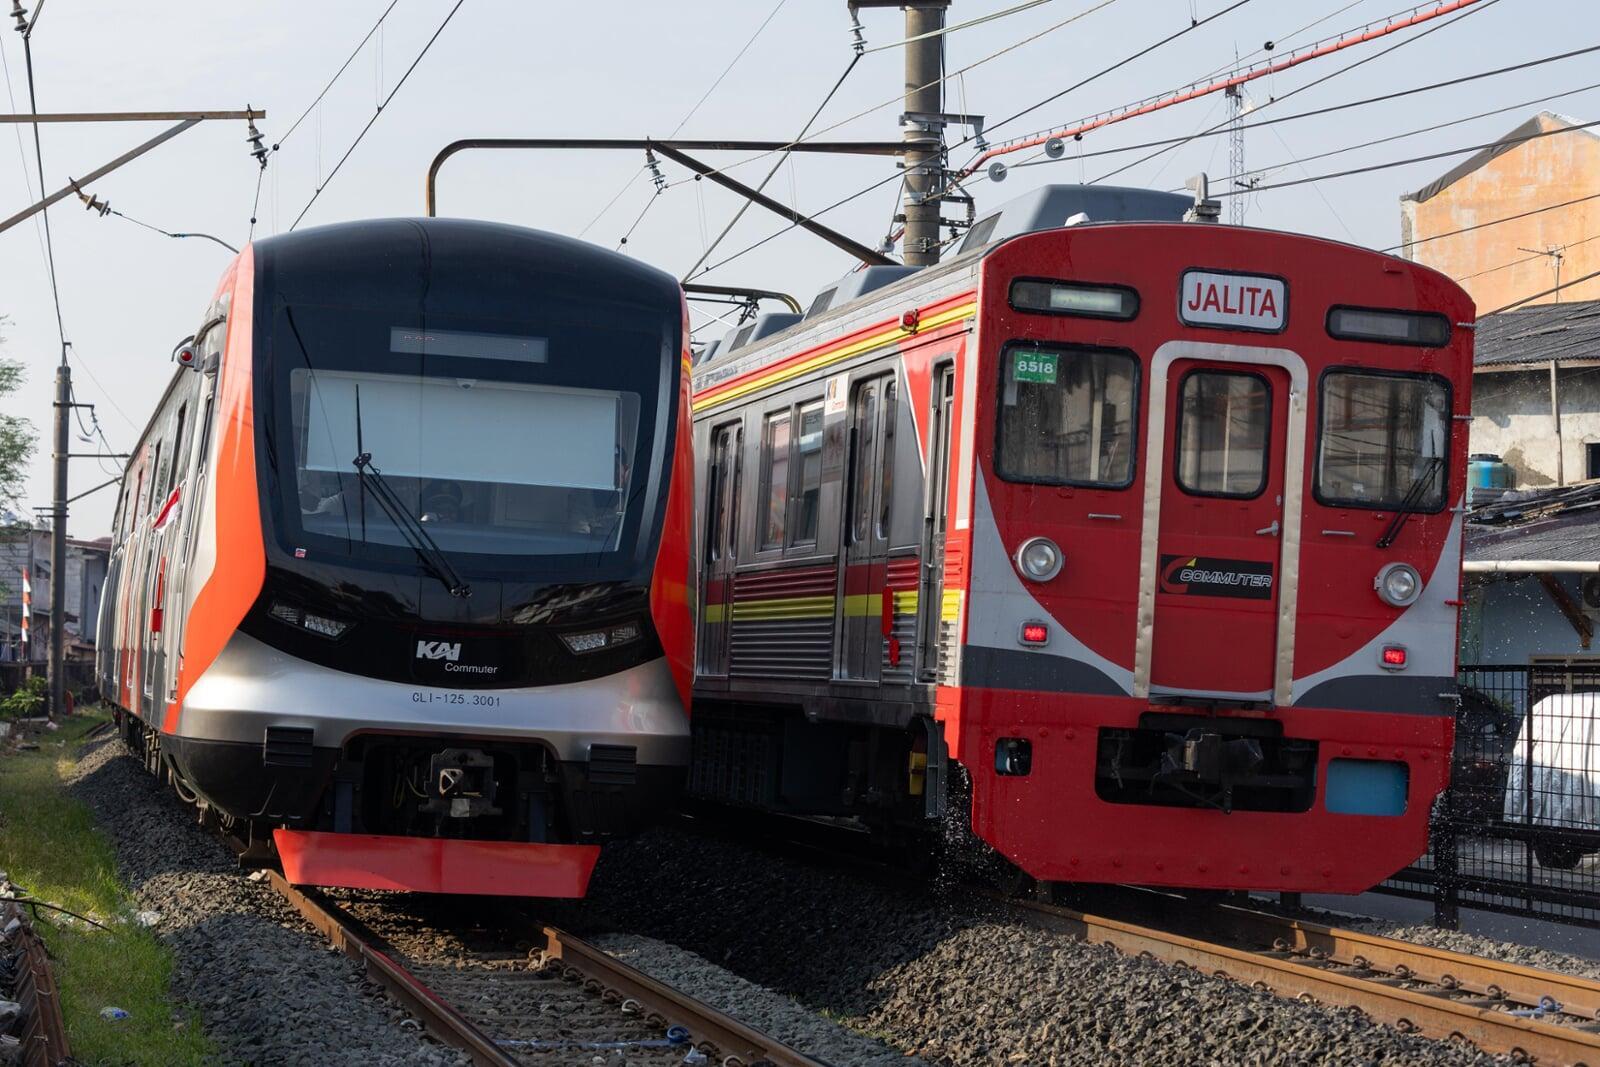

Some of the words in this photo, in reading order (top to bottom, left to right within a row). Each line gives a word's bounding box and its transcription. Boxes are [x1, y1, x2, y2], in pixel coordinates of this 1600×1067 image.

[1188, 282, 1277, 318] JALITA
[1018, 360, 1054, 374] 8518
[1180, 569, 1272, 587] COMMUTER
[416, 640, 462, 661] KAI
[444, 662, 498, 674] Commuter
